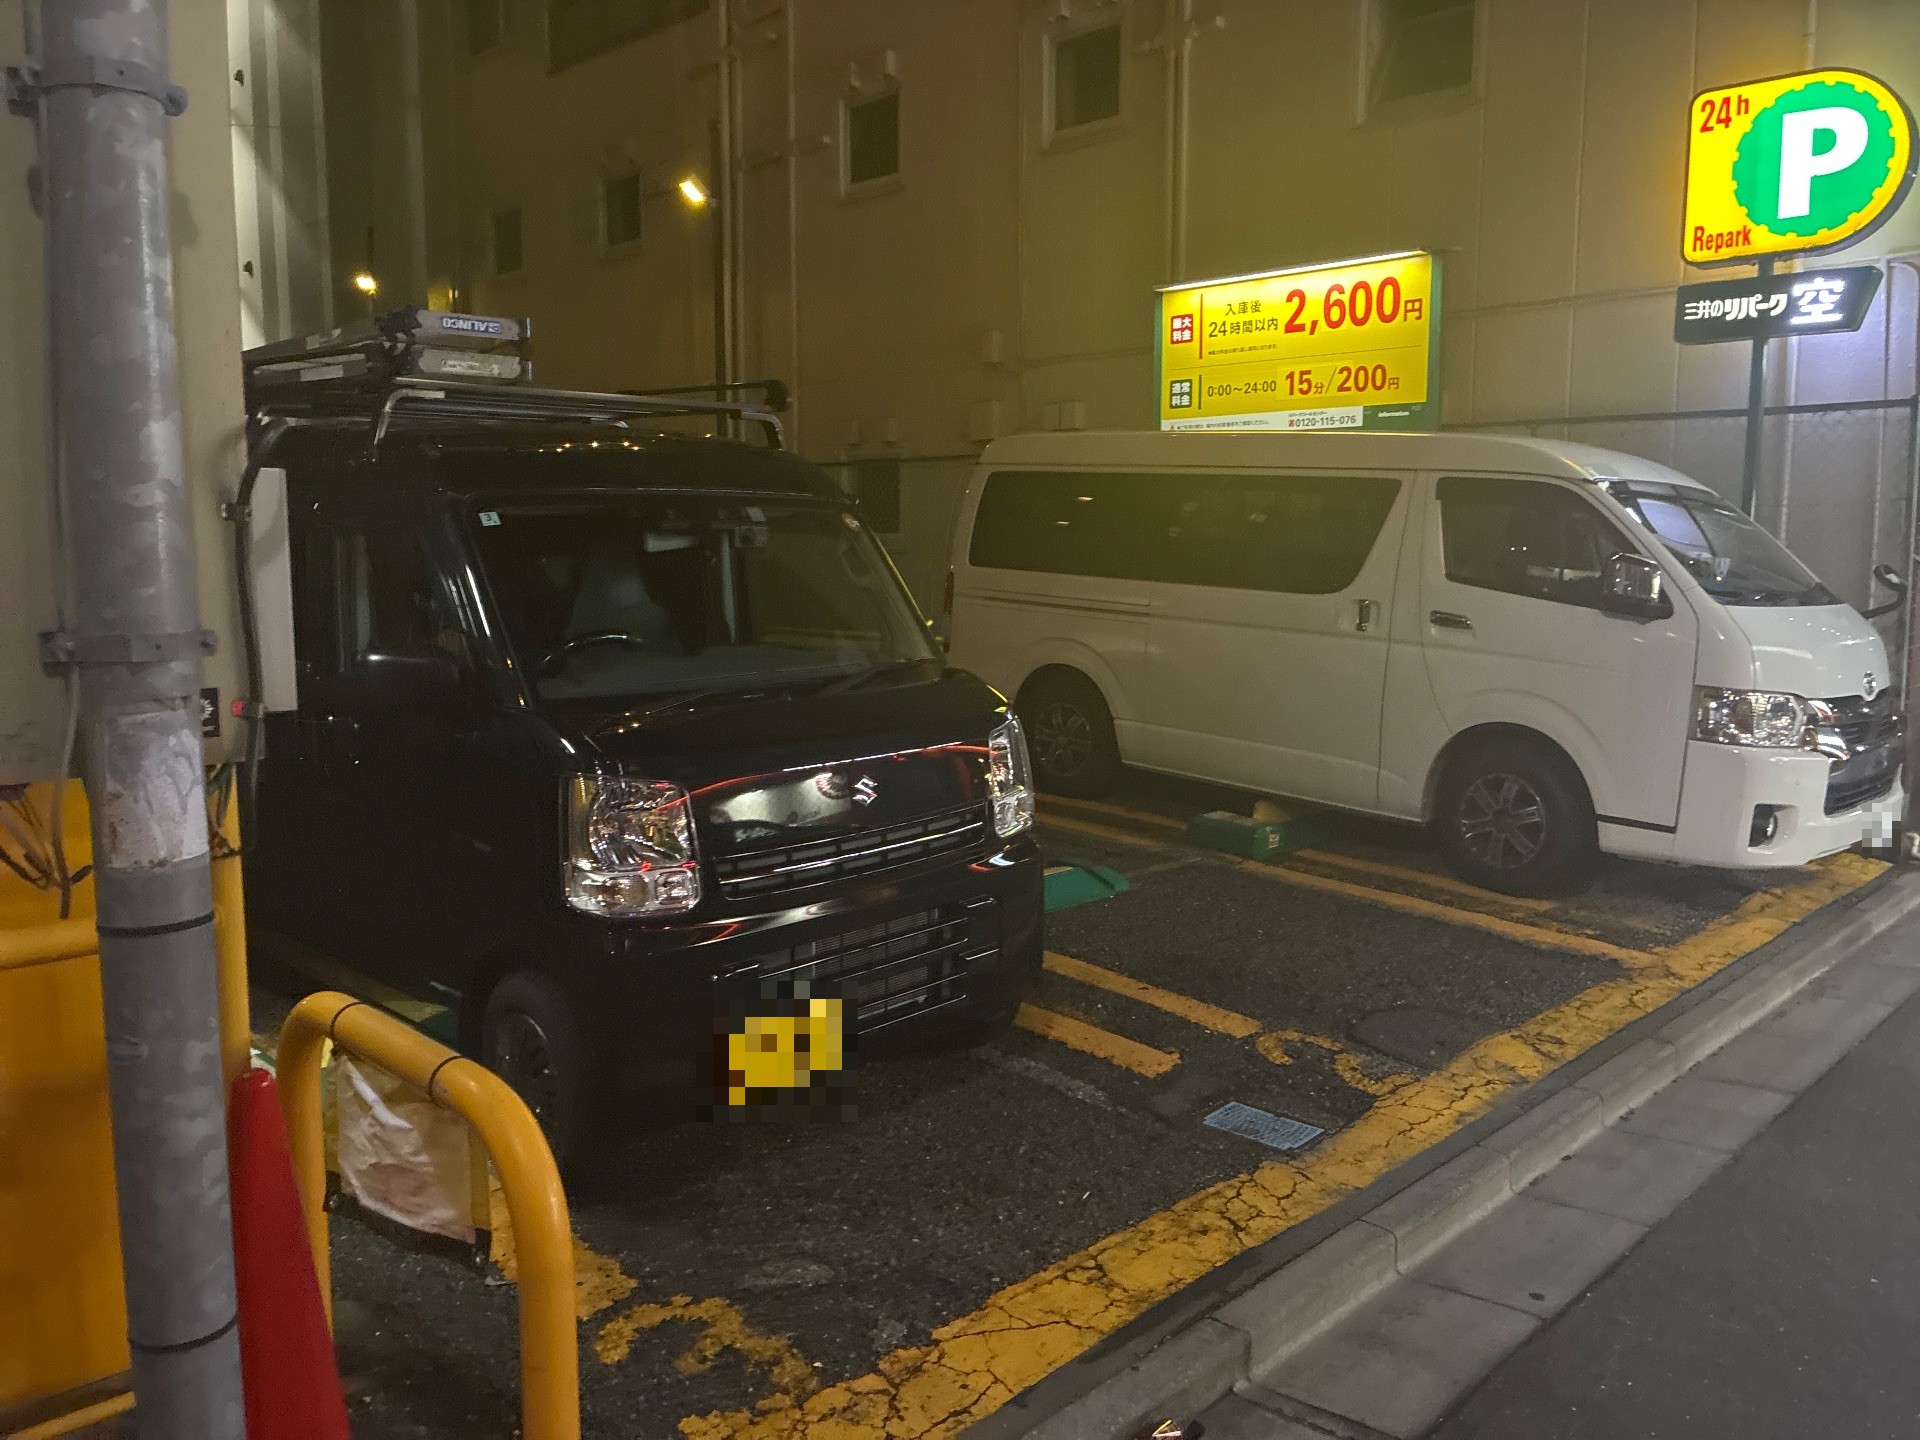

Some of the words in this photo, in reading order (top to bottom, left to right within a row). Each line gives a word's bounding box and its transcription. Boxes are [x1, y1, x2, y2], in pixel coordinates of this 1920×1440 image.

[1699, 94, 1750, 133] 24h
[1777, 106, 1869, 220] P
[1692, 225, 1752, 253] Repark
[1225, 299, 1262, 316] 入庫後
[1283, 276, 1423, 337] 2,600円
[1683, 293, 1788, 322] 三井のリパーク
[1790, 276, 1846, 326] 空
[1172, 329, 1192, 342] 料金
[1208, 317, 1279, 338] 24時間以内
[1171, 394, 1191, 407] 料金
[1295, 415, 1357, 427] 0120-115-076
